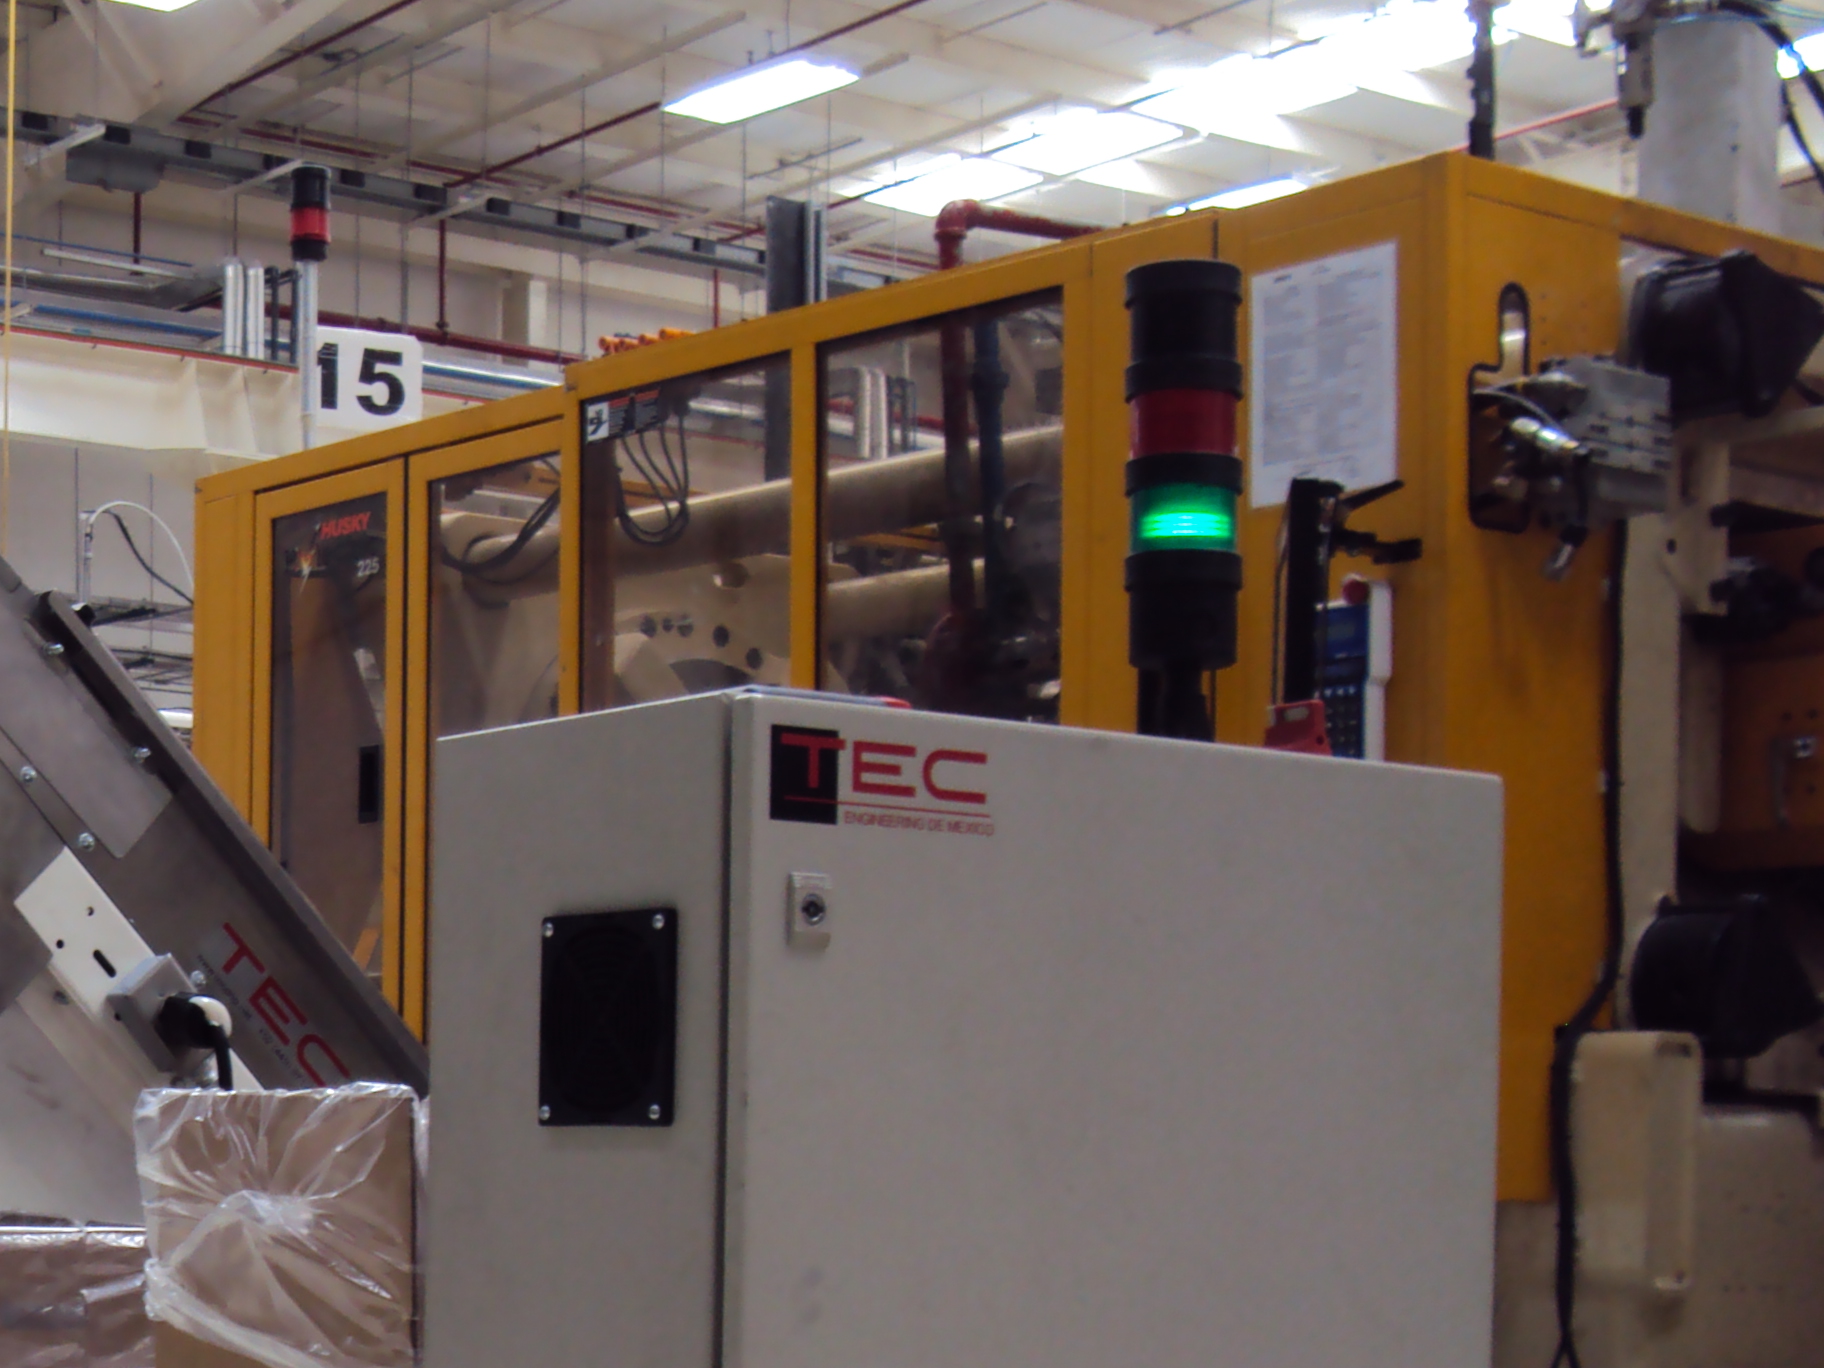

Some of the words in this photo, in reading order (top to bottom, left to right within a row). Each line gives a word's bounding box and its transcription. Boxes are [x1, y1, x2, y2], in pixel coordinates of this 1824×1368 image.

[317, 342, 405, 416] 15
[320, 511, 372, 540] HUSKY
[357, 557, 379, 578] 225
[780, 732, 988, 804] TEC
[844, 810, 925, 831] ENGINEERING
[928, 819, 943, 832] DE
[222, 922, 351, 1087] TEC
